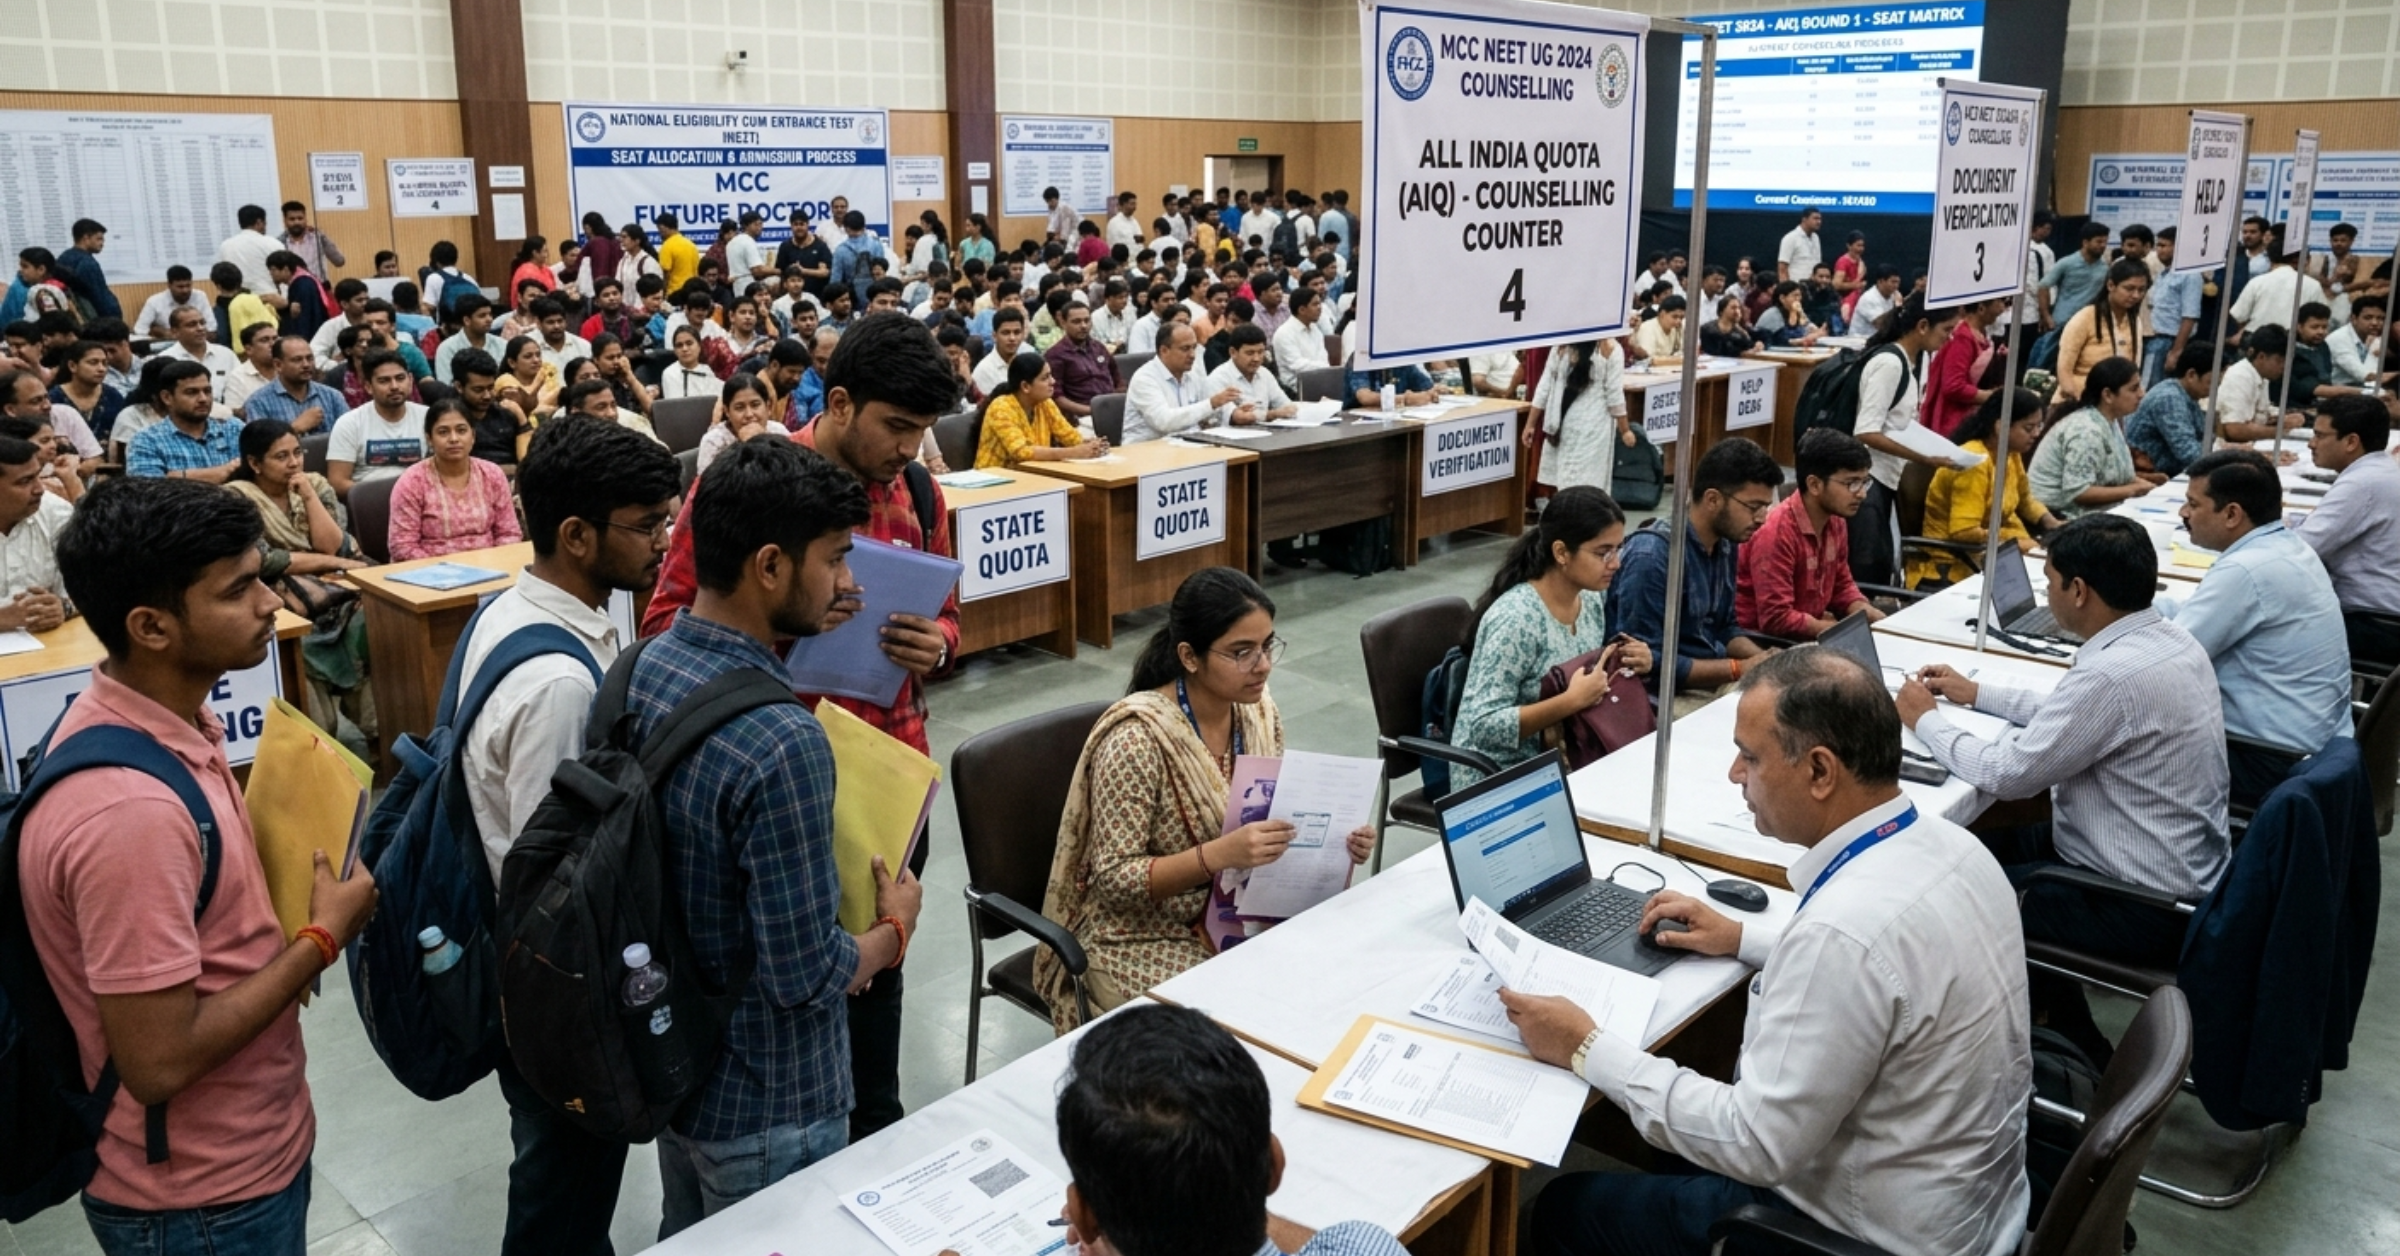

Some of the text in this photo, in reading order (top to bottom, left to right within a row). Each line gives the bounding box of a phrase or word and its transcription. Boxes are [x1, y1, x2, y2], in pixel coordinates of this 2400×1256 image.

[1853, 13, 1861, 27] 1
[1872, 11, 1907, 25] SEAT
[1440, 33, 1592, 69] MCC NEET UG 2024
[1460, 71, 1574, 101] COUNSELLING
[610, 113, 670, 126] NATIONAL
[742, 115, 767, 127] CUM
[829, 117, 854, 129] TEST
[611, 150, 644, 164] SEAT
[1419, 139, 1600, 173] ALL INDIA QUOTA
[716, 171, 769, 192] MCC
[2195, 179, 2225, 215] HELP
[635, 203, 729, 224] FUTURE
[1398, 180, 1455, 220] (AIQ)
[1475, 179, 1615, 209] COUNSELLING
[1462, 219, 1563, 252] COUNTER
[2200, 225, 2209, 257] 3
[1973, 242, 1985, 282] 3
[1498, 267, 1526, 322] 4
[1157, 478, 1208, 509] STATE
[981, 511, 1046, 545] STATE
[1154, 507, 1210, 540] QUOTA
[978, 543, 1049, 580] QUOTA
